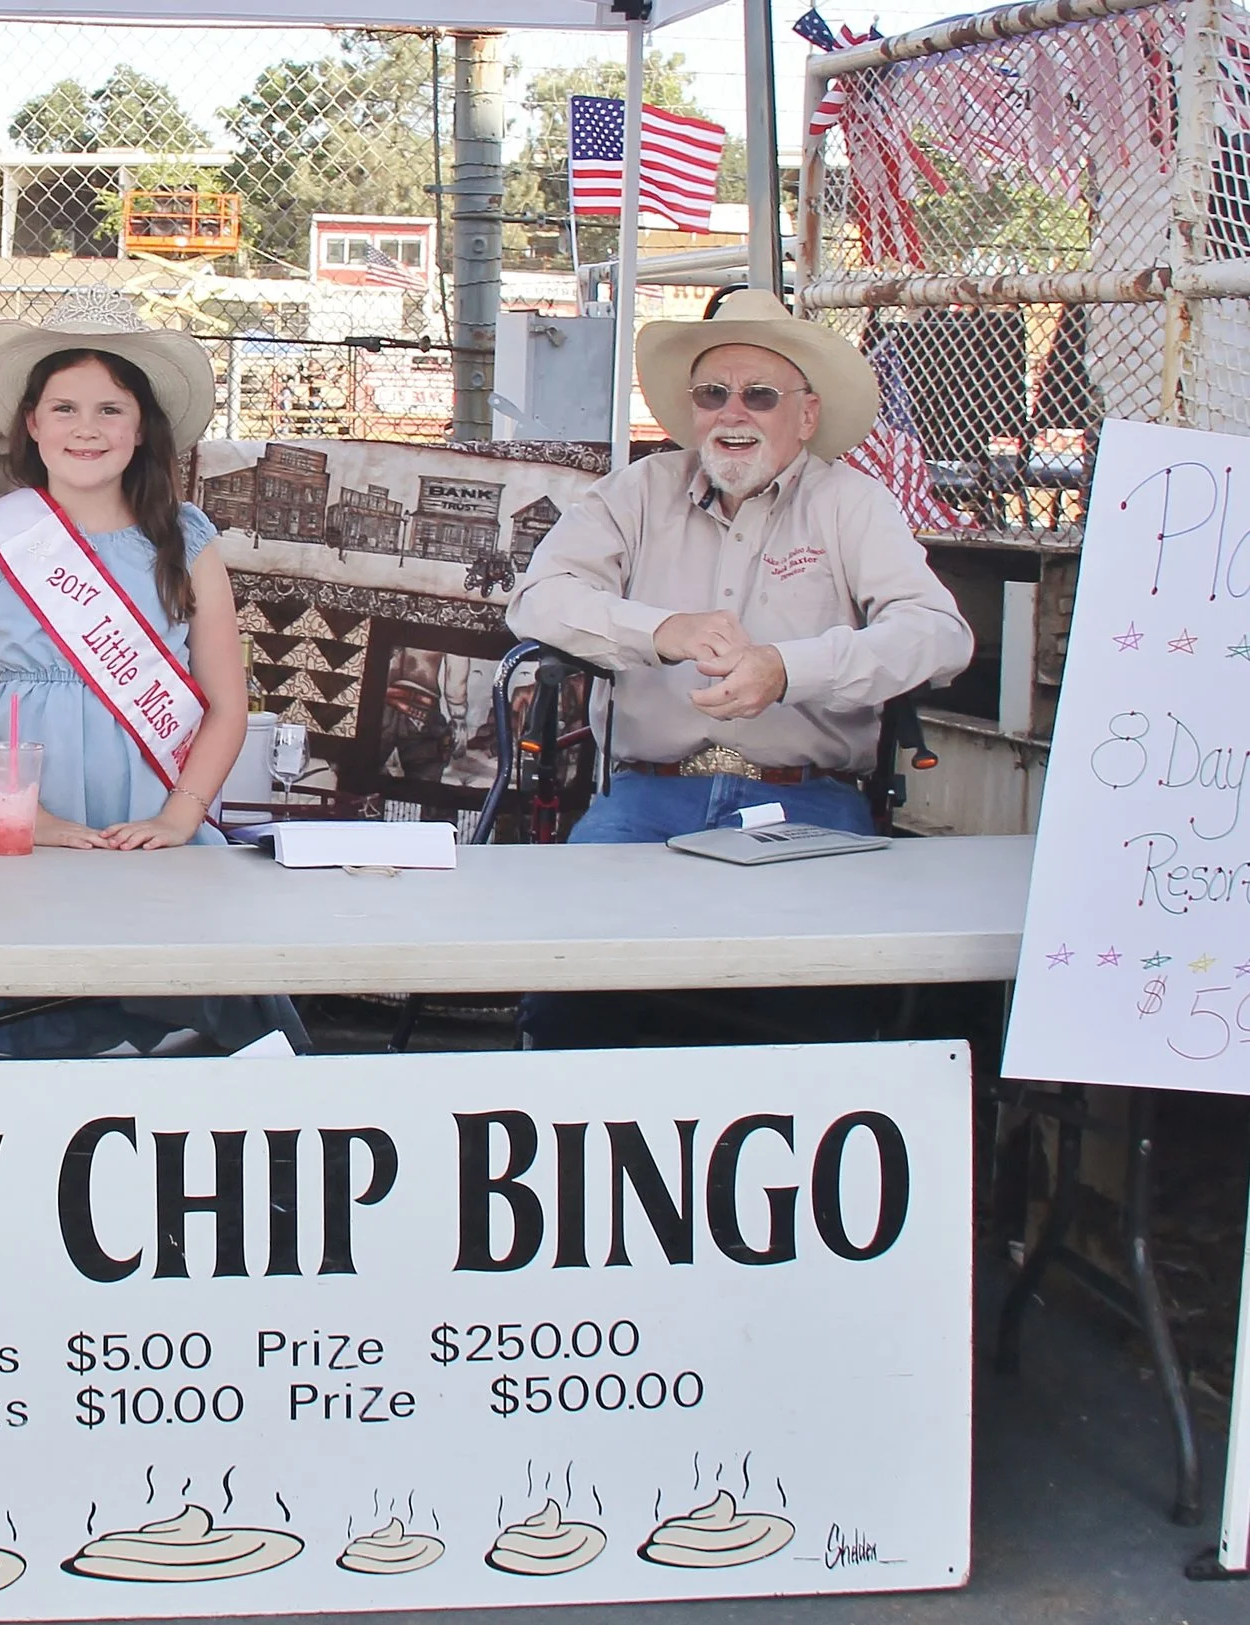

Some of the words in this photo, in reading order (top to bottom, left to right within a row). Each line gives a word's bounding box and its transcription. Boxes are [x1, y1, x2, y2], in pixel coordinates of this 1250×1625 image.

[429, 485, 492, 500] BANK
[441, 501, 479, 512] TRUST
[46, 567, 101, 606] 2017
[81, 615, 138, 685] Little
[133, 679, 180, 739] Miss
[1091, 711, 1149, 789] 8
[451, 1110, 911, 1275] BINGO
[66, 1331, 213, 1375] $5.00
[430, 1320, 641, 1365] $250.00
[75, 1383, 245, 1428] $10.00
[490, 1371, 705, 1418] $500.00
